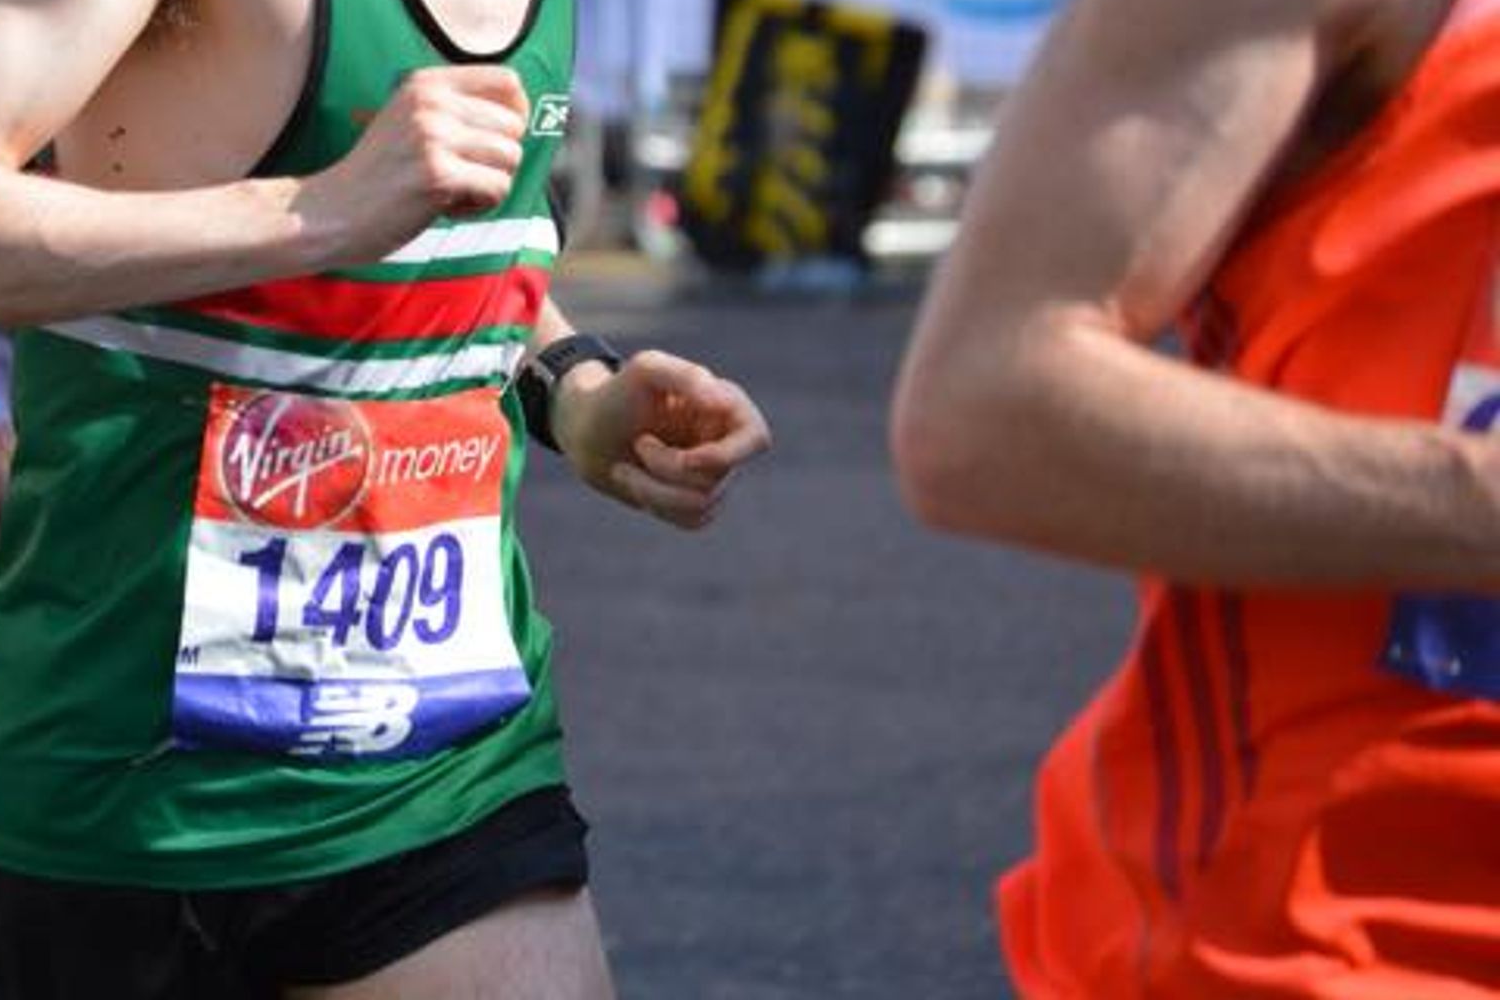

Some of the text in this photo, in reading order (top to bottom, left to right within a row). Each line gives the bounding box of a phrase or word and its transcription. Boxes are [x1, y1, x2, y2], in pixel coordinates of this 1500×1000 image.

[228, 398, 498, 517] Virgin money
[240, 533, 464, 651] 1409
